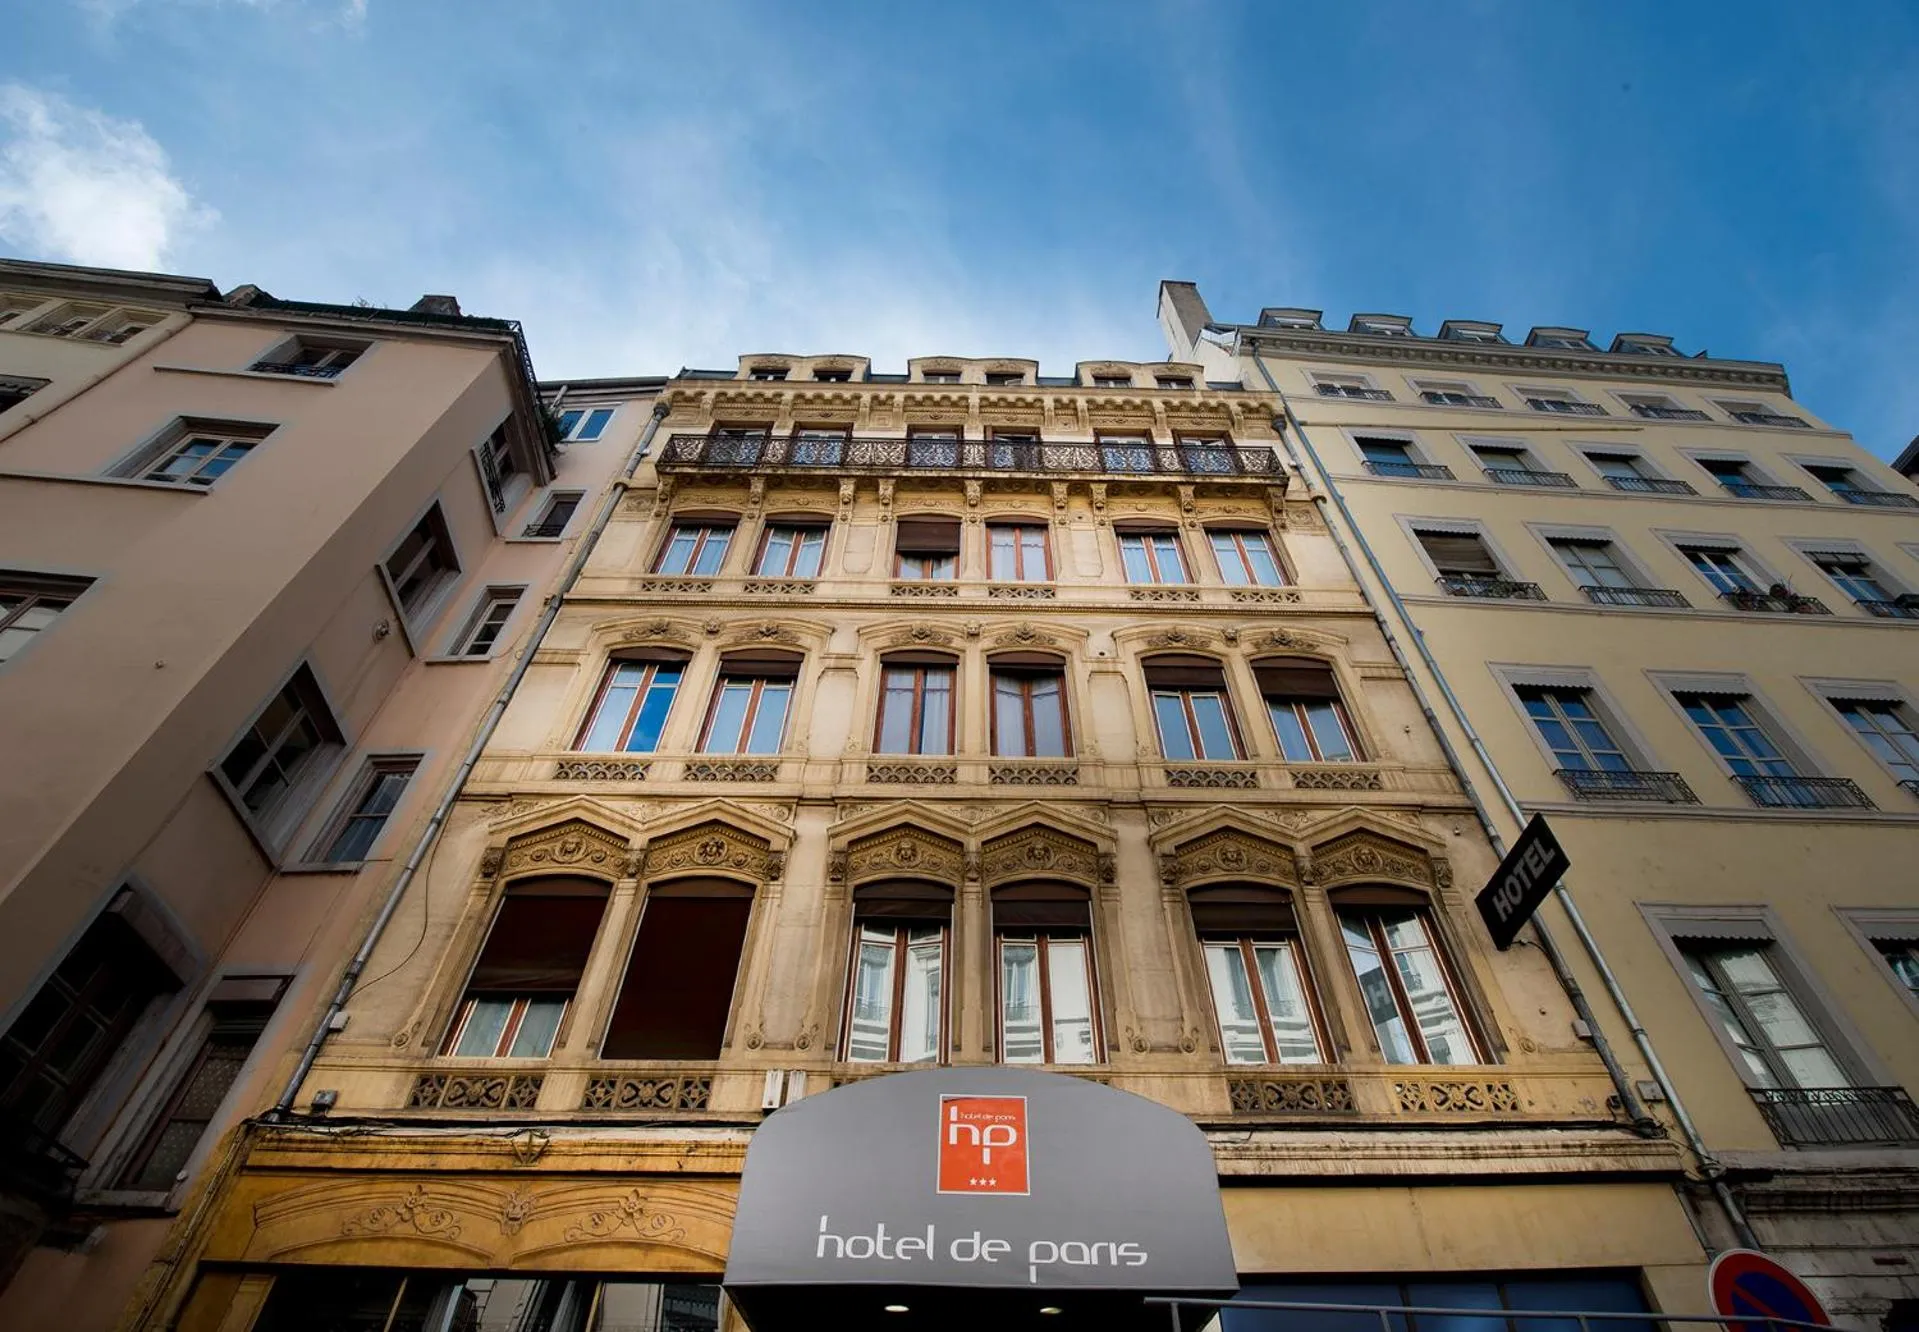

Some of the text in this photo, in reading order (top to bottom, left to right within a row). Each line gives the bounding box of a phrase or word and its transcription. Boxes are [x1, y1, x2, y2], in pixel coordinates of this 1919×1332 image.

[1492, 837, 1556, 923] HOTEL
[949, 1105, 1017, 1165] hp
[816, 1215, 1148, 1283] hotel de paris
